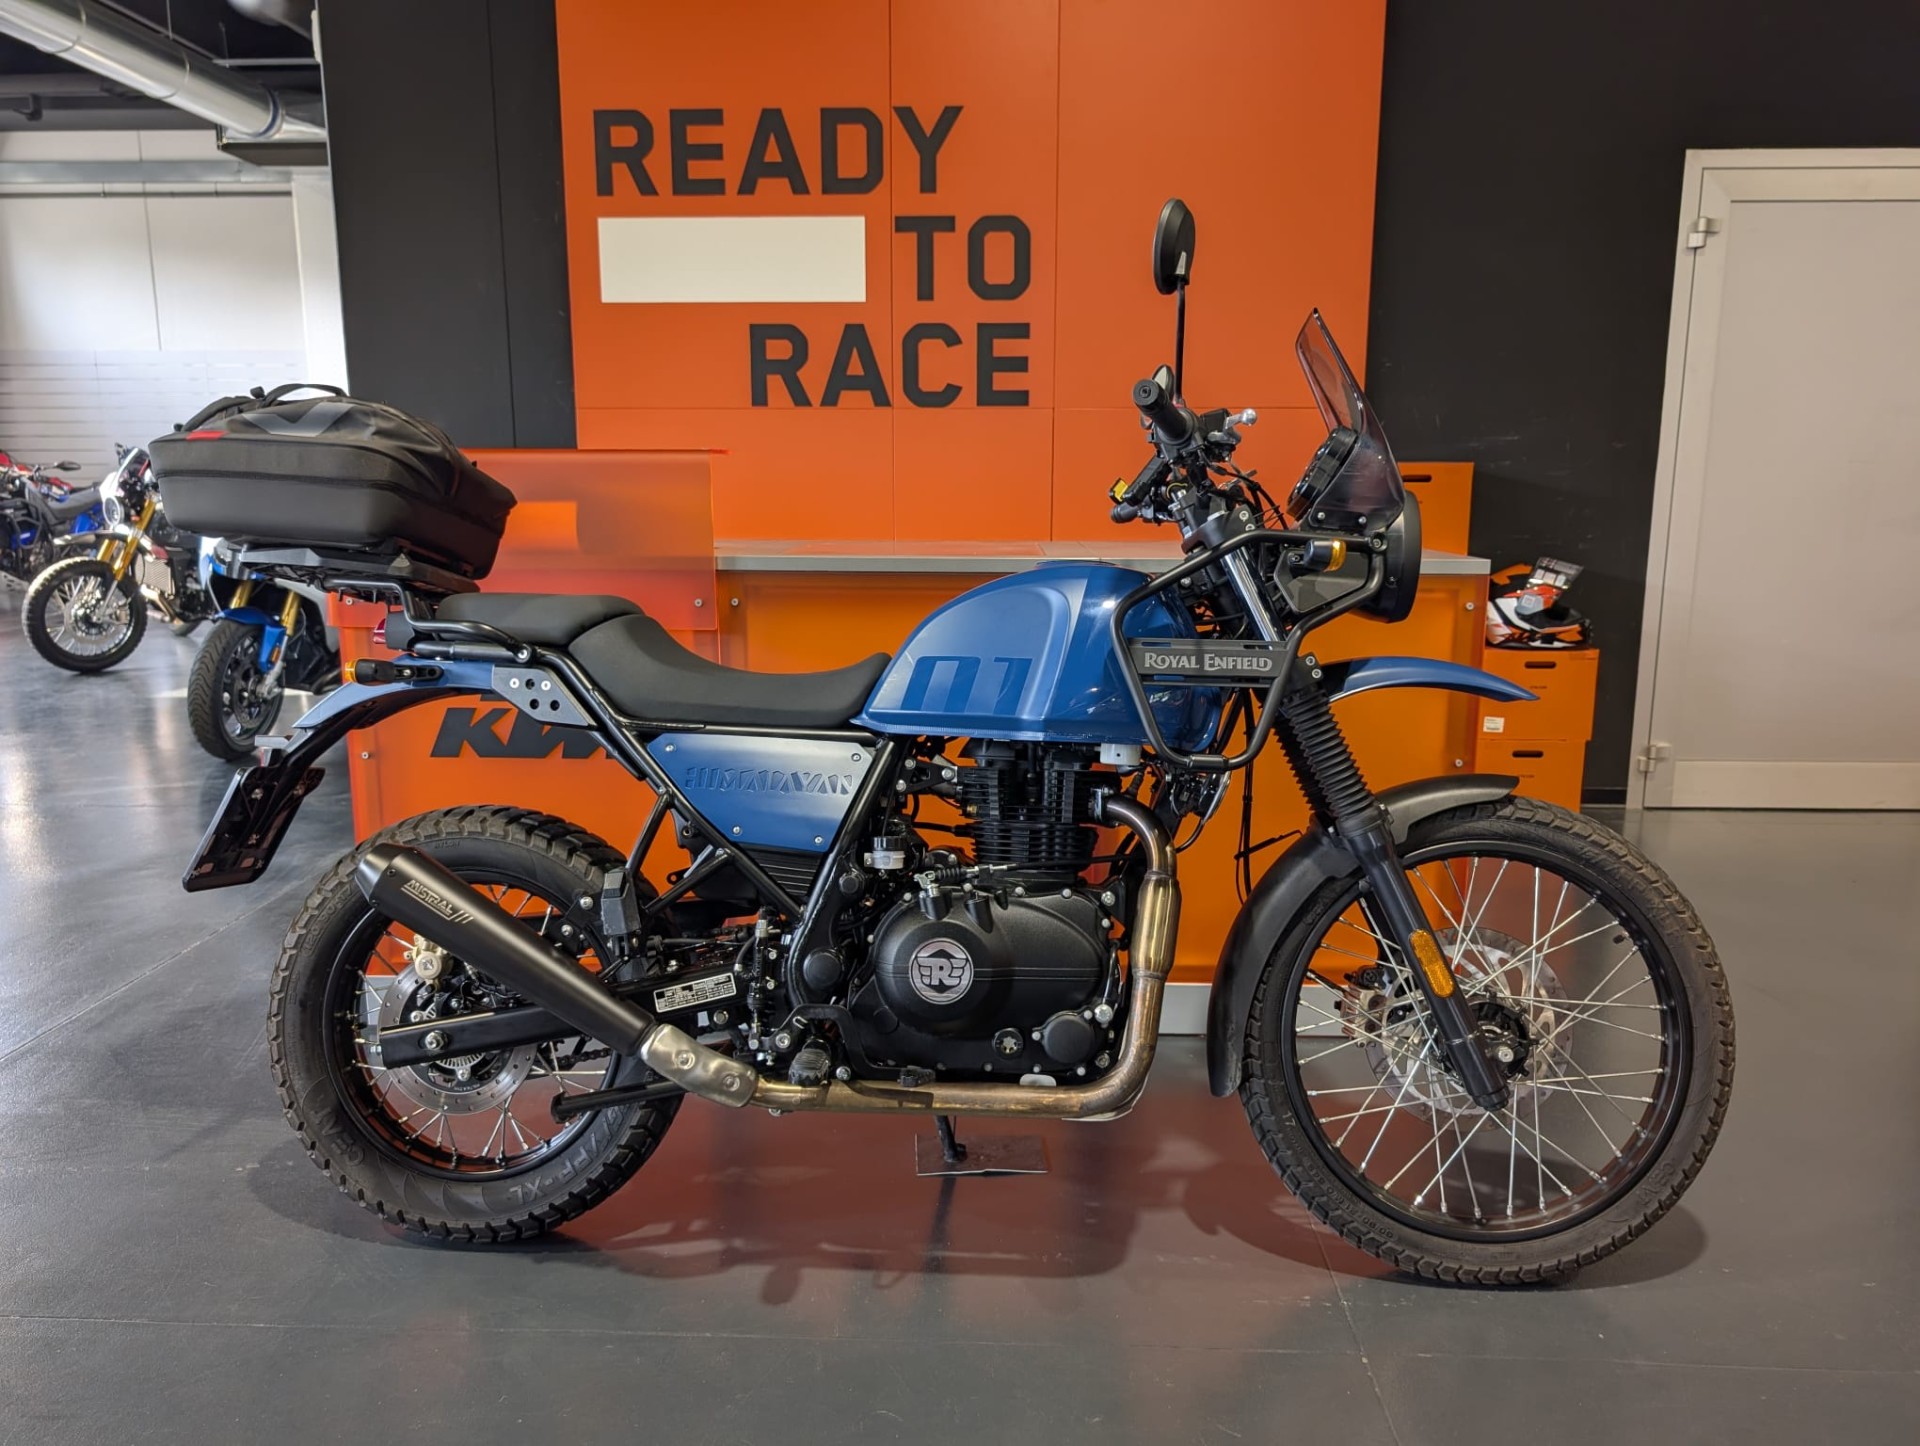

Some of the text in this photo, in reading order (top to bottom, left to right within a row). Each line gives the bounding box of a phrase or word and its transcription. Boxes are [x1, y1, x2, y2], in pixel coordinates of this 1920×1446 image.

[593, 106, 964, 196] READY
[895, 215, 1031, 301] TO
[749, 323, 1030, 408] RACE
[1144, 652, 1272, 672] ROYAL ENFIELD
[685, 767, 854, 795] HIMALAYAN
[404, 879, 454, 916] MISTRAL
